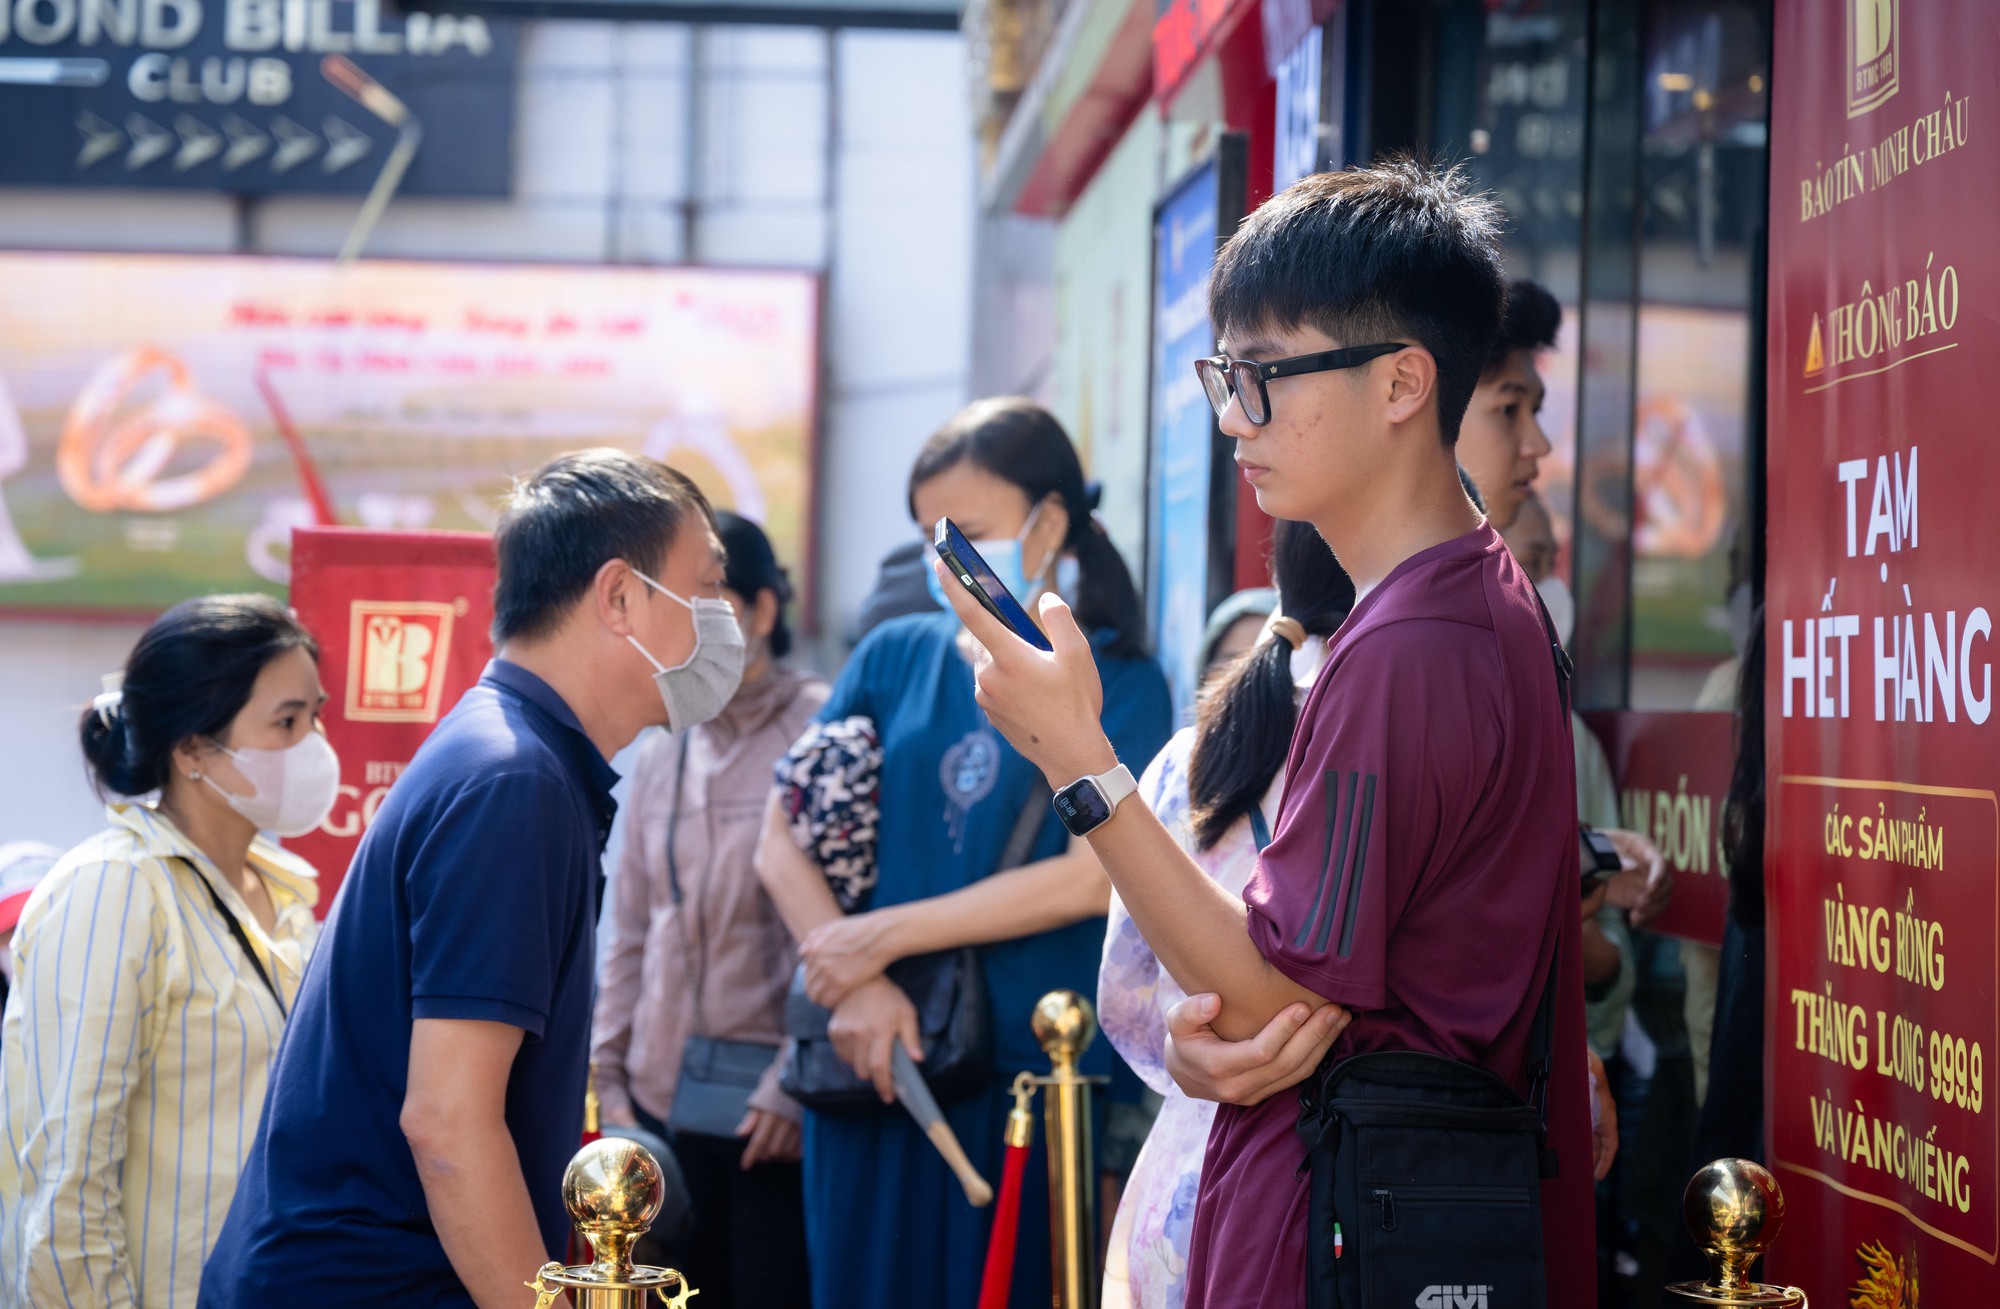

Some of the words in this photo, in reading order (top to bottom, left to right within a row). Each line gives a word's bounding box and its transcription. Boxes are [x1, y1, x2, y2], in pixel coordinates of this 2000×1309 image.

[0, 0, 204, 48] OND
[127, 52, 293, 104] CLUB
[1870, 125, 1909, 192] MINH
[1912, 90, 1970, 166] CHÂU
[1828, 280, 1902, 368] THÔNG
[1905, 251, 1959, 342] BÁO
[1838, 445, 1918, 583] TẠM
[1783, 577, 1860, 718] HẾT
[1874, 583, 1992, 725] HÀNG
[1655, 774, 1711, 875] ĐÓN
[1825, 803, 1853, 858] CÁC
[1858, 802, 1900, 862] SẢN
[1901, 806, 1943, 871] PHẨM
[1825, 882, 1891, 973] VÀNG
[1896, 887, 1945, 991] RỒNG
[1791, 980, 1868, 1071] THĂNG
[1877, 1011, 1925, 1093] LONG
[1930, 1030, 1983, 1114] 999.9
[1810, 1088, 1835, 1155] VÀ
[1837, 1099, 1906, 1179] VÀNG
[1907, 1125, 1970, 1213] MIẾNG
[1415, 1285, 1488, 1309] GIVI
